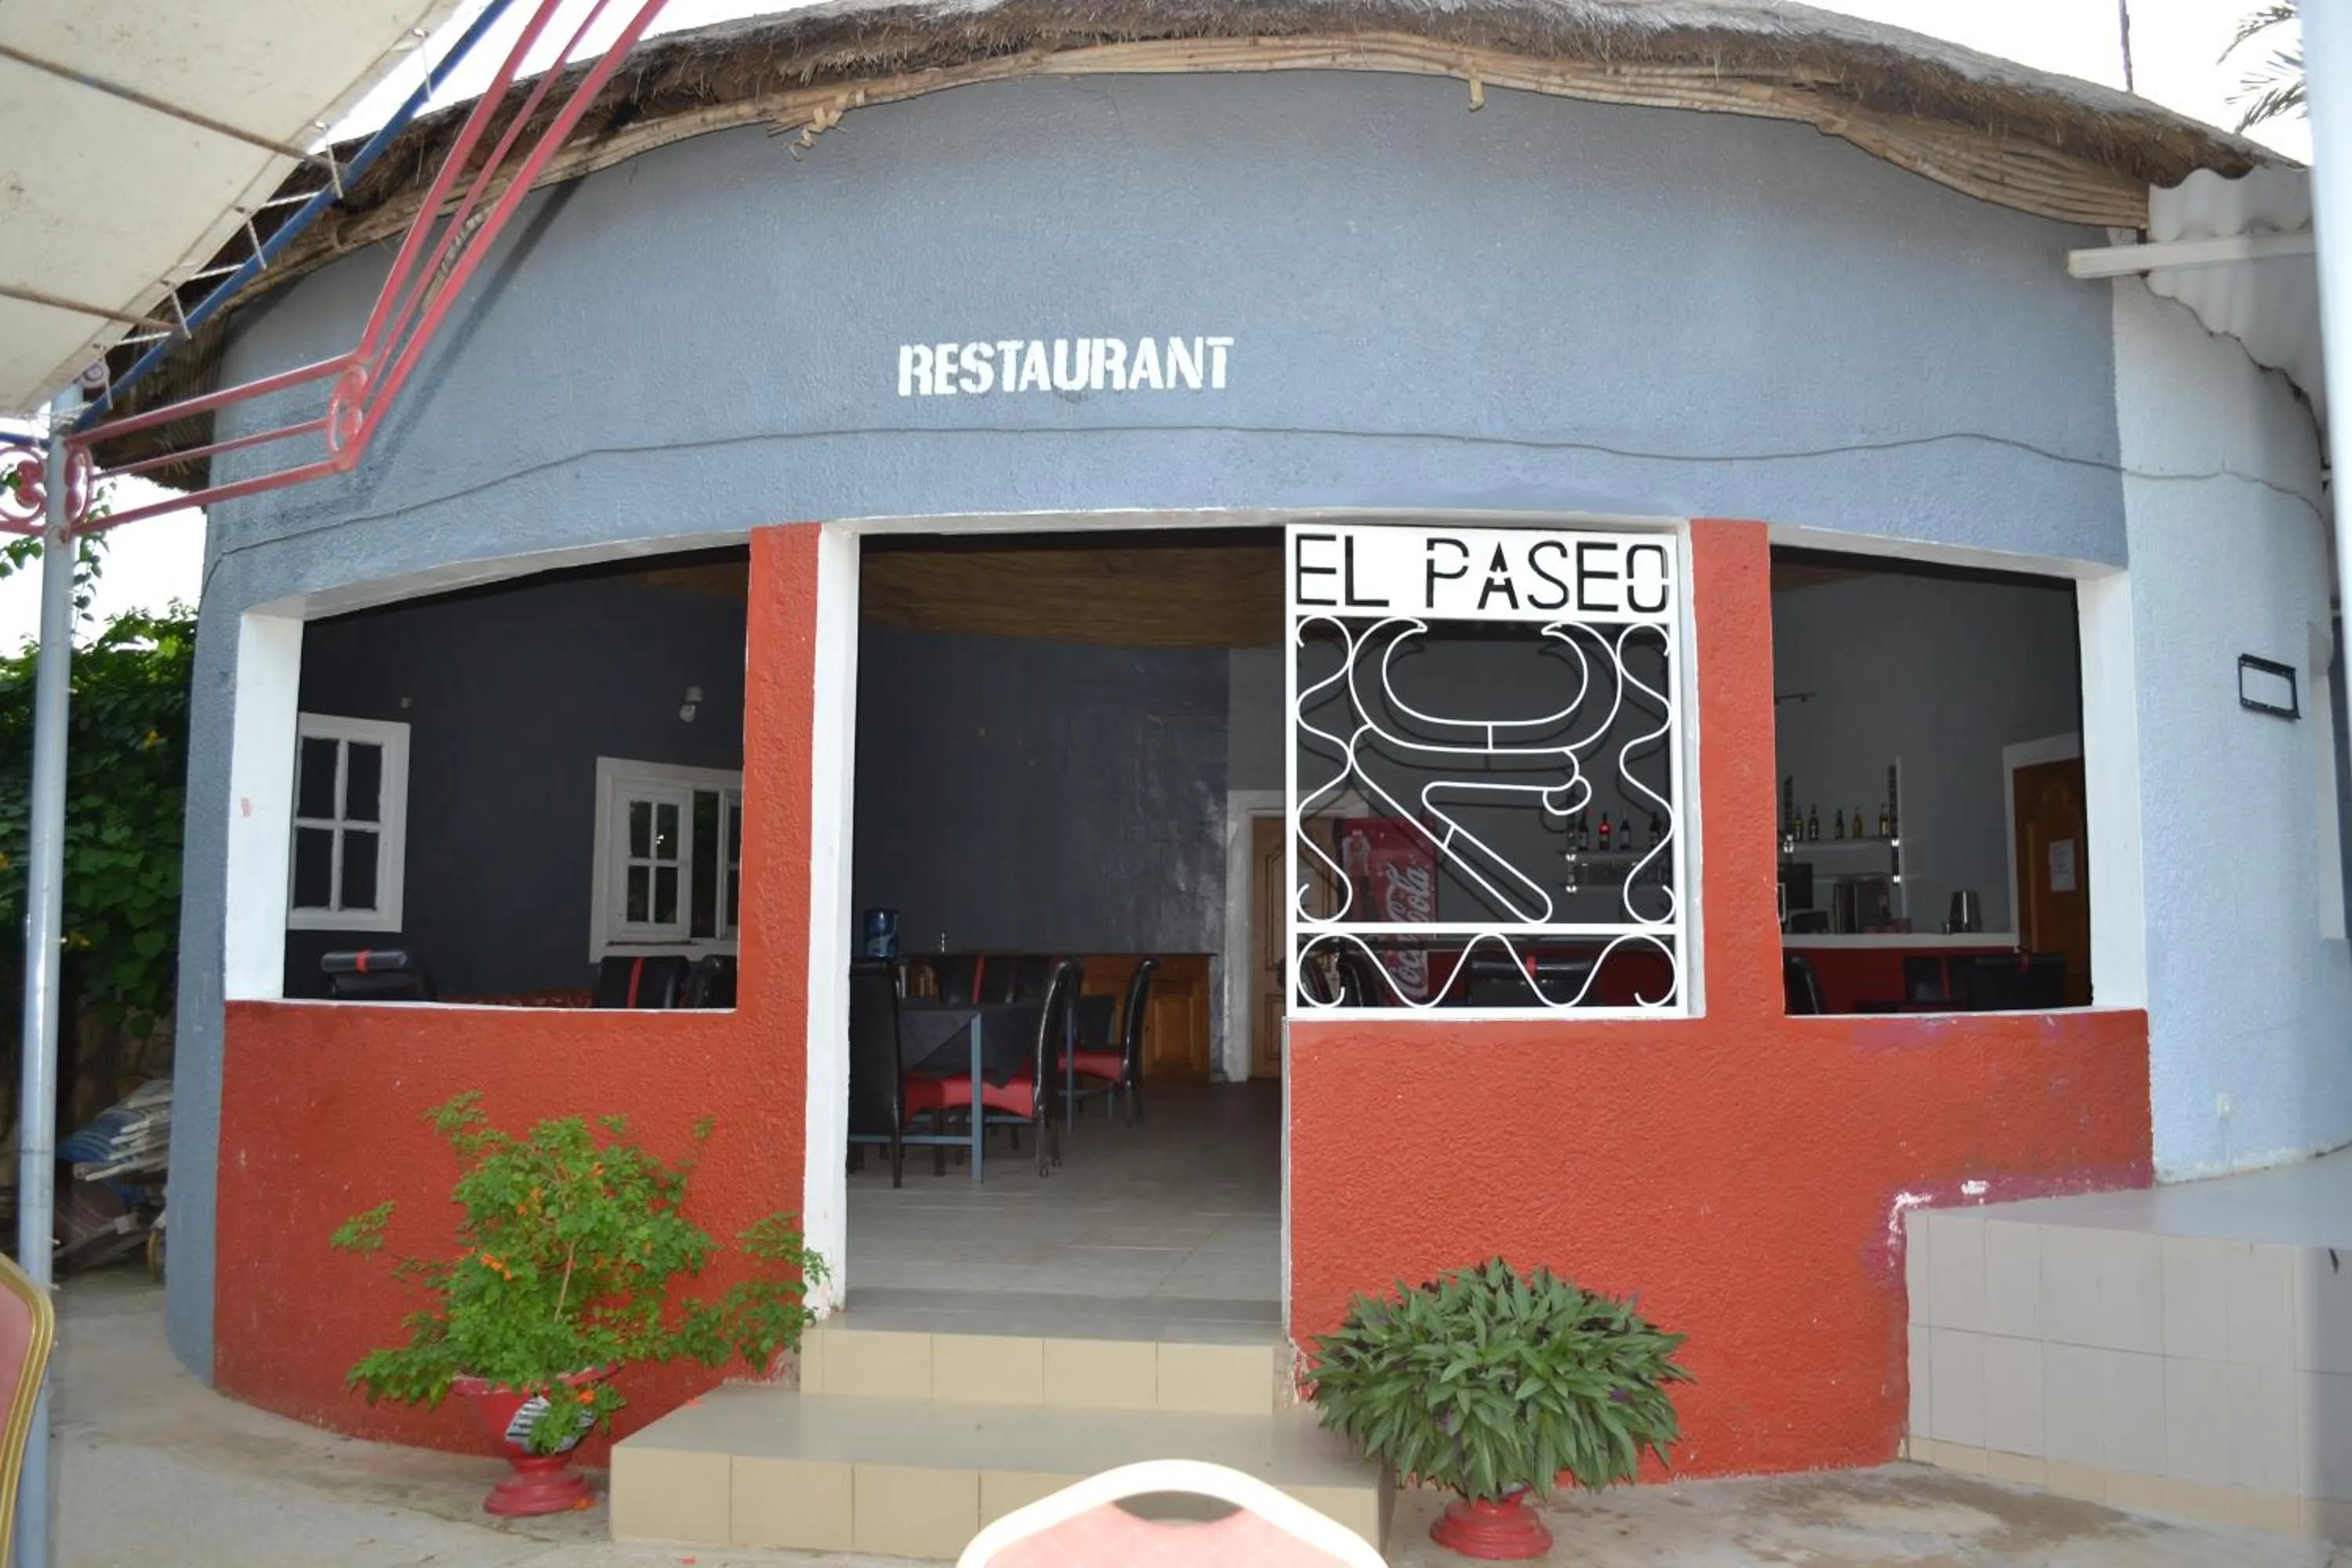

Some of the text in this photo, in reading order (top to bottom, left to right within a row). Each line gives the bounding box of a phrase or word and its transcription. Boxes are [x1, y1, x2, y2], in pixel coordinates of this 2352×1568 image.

[898, 337, 1234, 396] RESTAURANT
[1296, 534, 1669, 613] EL PASEO
[1386, 862, 1430, 998] CocCola
